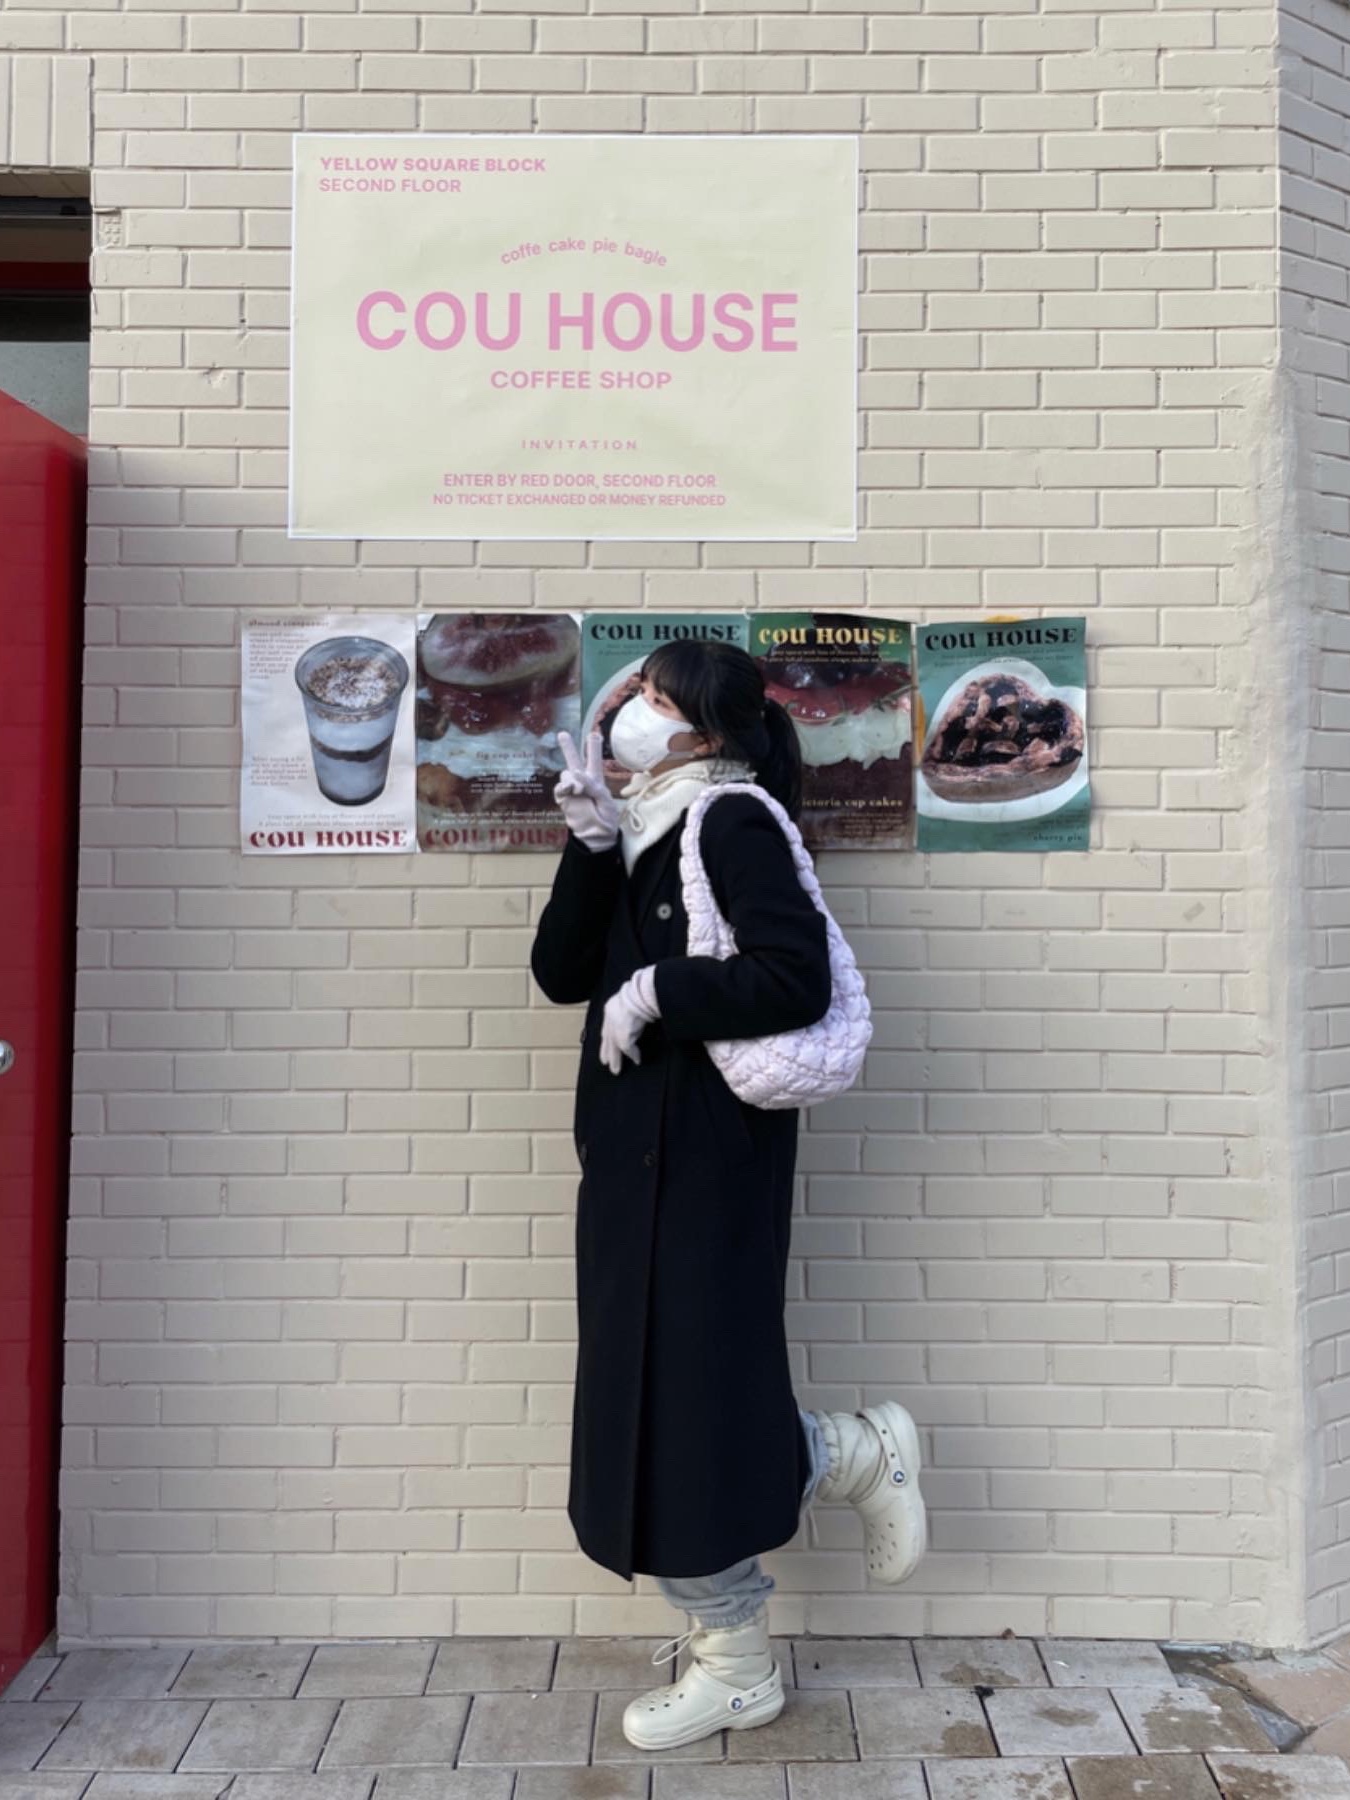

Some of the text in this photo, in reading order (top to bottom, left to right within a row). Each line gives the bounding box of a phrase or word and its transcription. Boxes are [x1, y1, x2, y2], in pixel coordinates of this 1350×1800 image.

[320, 157, 546, 172] YELLOW SQUARE BLOCK
[319, 178, 461, 193] SECOND FLOOR
[501, 238, 667, 267] coffe cake pie bagle
[356, 290, 799, 352] COU HOUSE
[490, 370, 672, 390] COFFEE SHOP
[522, 439, 638, 450] INVITATION
[444, 473, 716, 489] ENTER BY RED DOOR, SECOND FLOOR
[433, 494, 726, 506] NO TICKET EXCHANGED OR MONEY REFUNDED
[590, 623, 741, 641] COU HOUSE
[758, 627, 903, 646] COU HOUSE
[925, 627, 1077, 651] COU HOUSE
[802, 795, 903, 809] ictoria cup cakes
[249, 829, 408, 848] COU HOUSE
